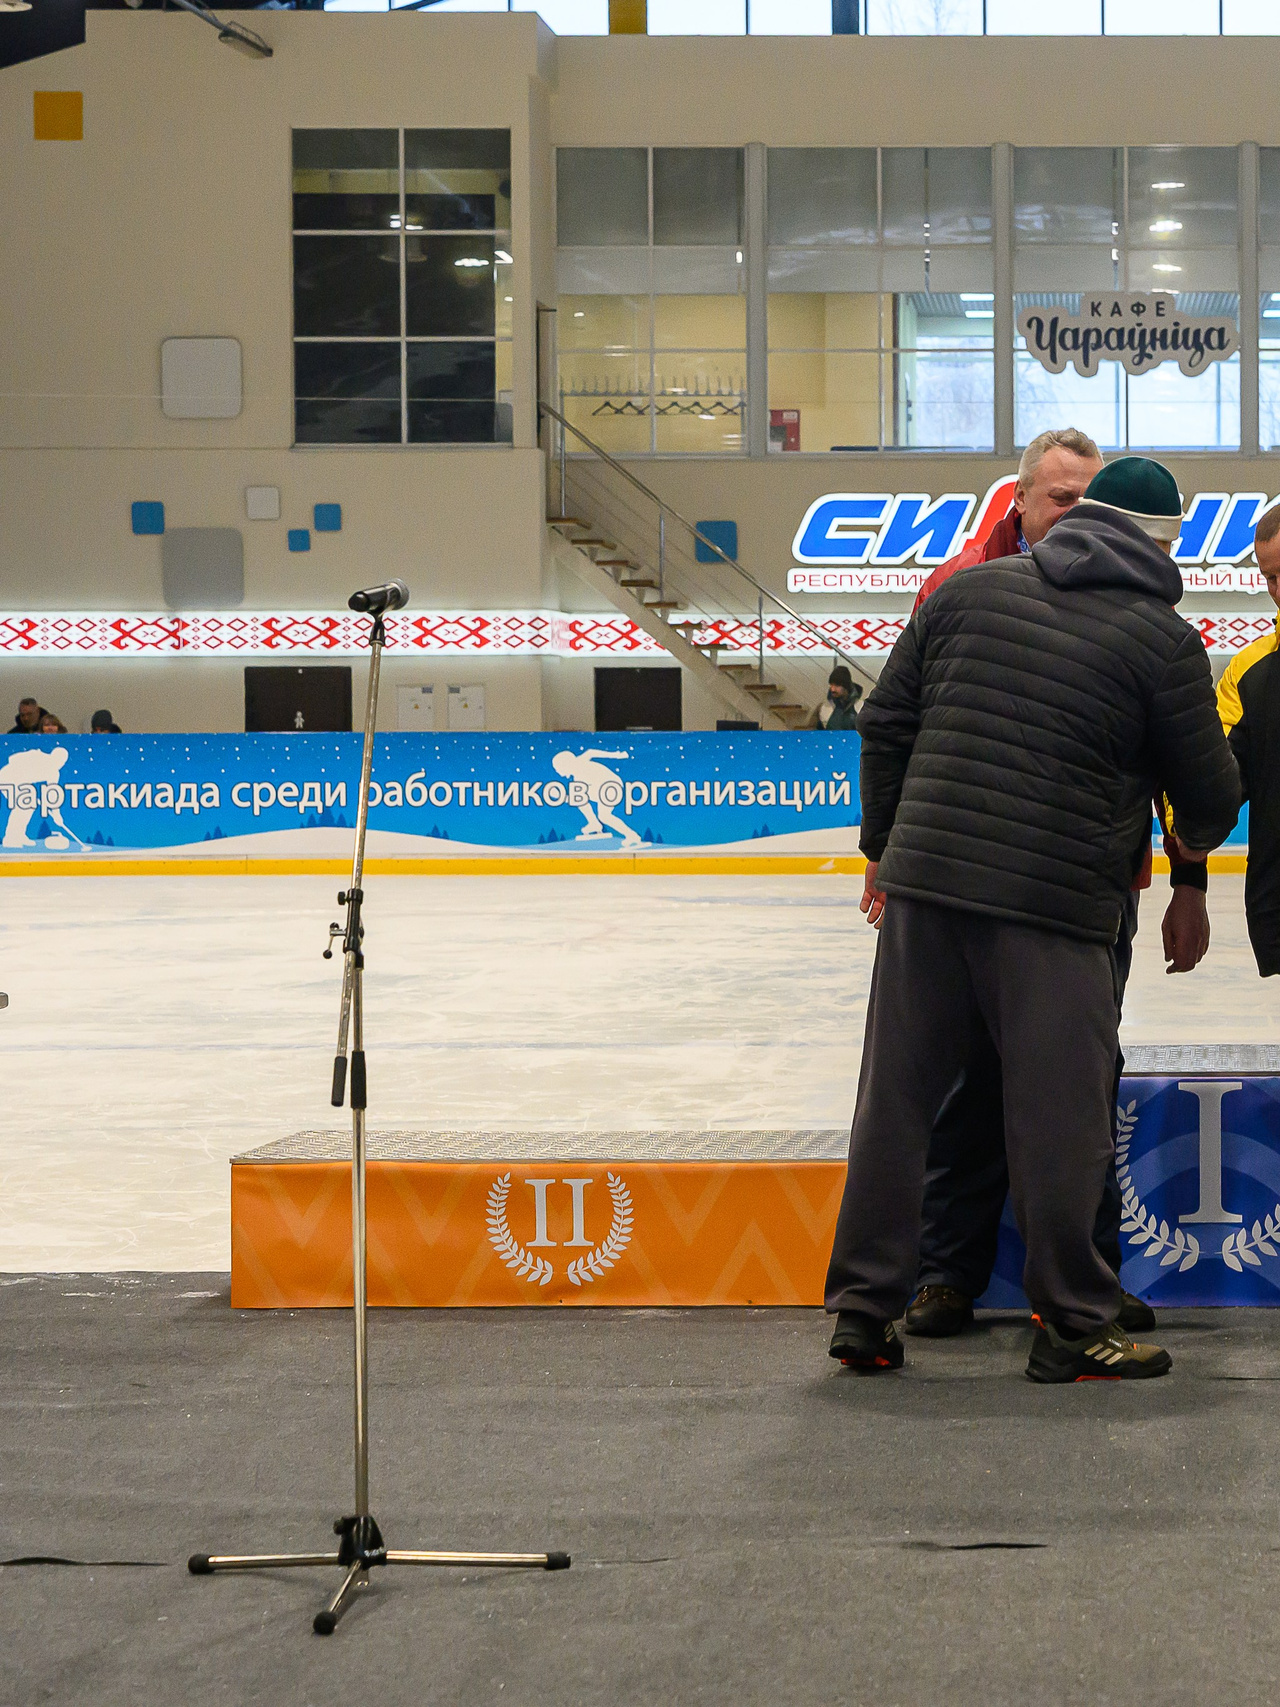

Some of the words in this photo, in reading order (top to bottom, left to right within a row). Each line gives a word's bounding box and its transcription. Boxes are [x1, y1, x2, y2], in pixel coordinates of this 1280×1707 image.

[1090, 301, 1166, 318] КАФЕ
[1182, 569, 1232, 586] НЫЙ
[1239, 573, 1268, 590] ЦЕ
[0, 782, 221, 818] партакиада
[231, 781, 347, 817] среди
[598, 771, 852, 815] организаций
[524, 1178, 595, 1247] II
